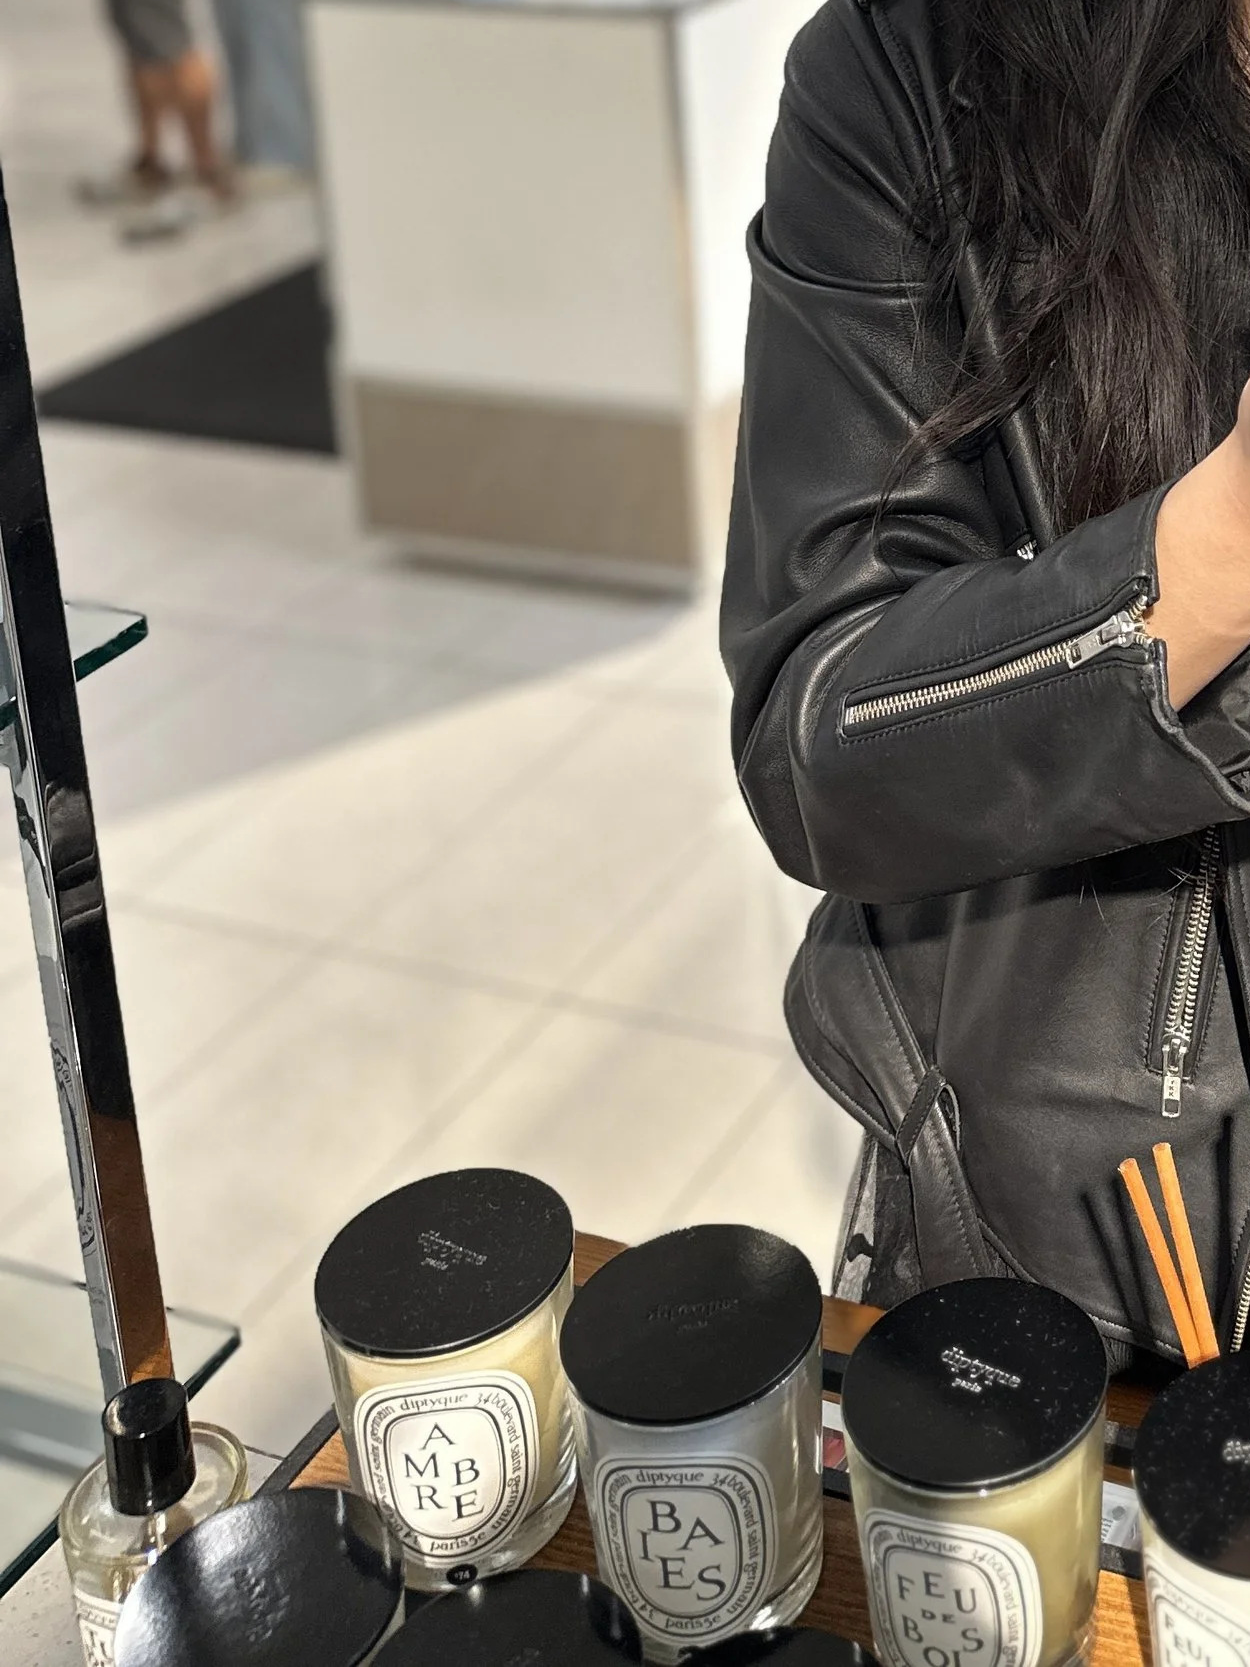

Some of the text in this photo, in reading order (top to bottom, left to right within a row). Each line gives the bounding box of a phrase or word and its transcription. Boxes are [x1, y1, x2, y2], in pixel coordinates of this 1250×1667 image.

[940, 1345, 1021, 1388] diptyque
[399, 1392, 470, 1412] diptyque
[951, 1377, 982, 1393] paris
[491, 1392, 520, 1441] boulevard
[510, 1443, 522, 1475] saint
[635, 1469, 705, 1486] diptyque
[491, 1475, 522, 1530] germain
[727, 1473, 760, 1529] boulevard
[747, 1528, 761, 1562] saint
[895, 1528, 964, 1555] diptyque
[726, 1561, 759, 1616] germain
[896, 1570, 978, 1615] FEU
[920, 1608, 957, 1625] DE
